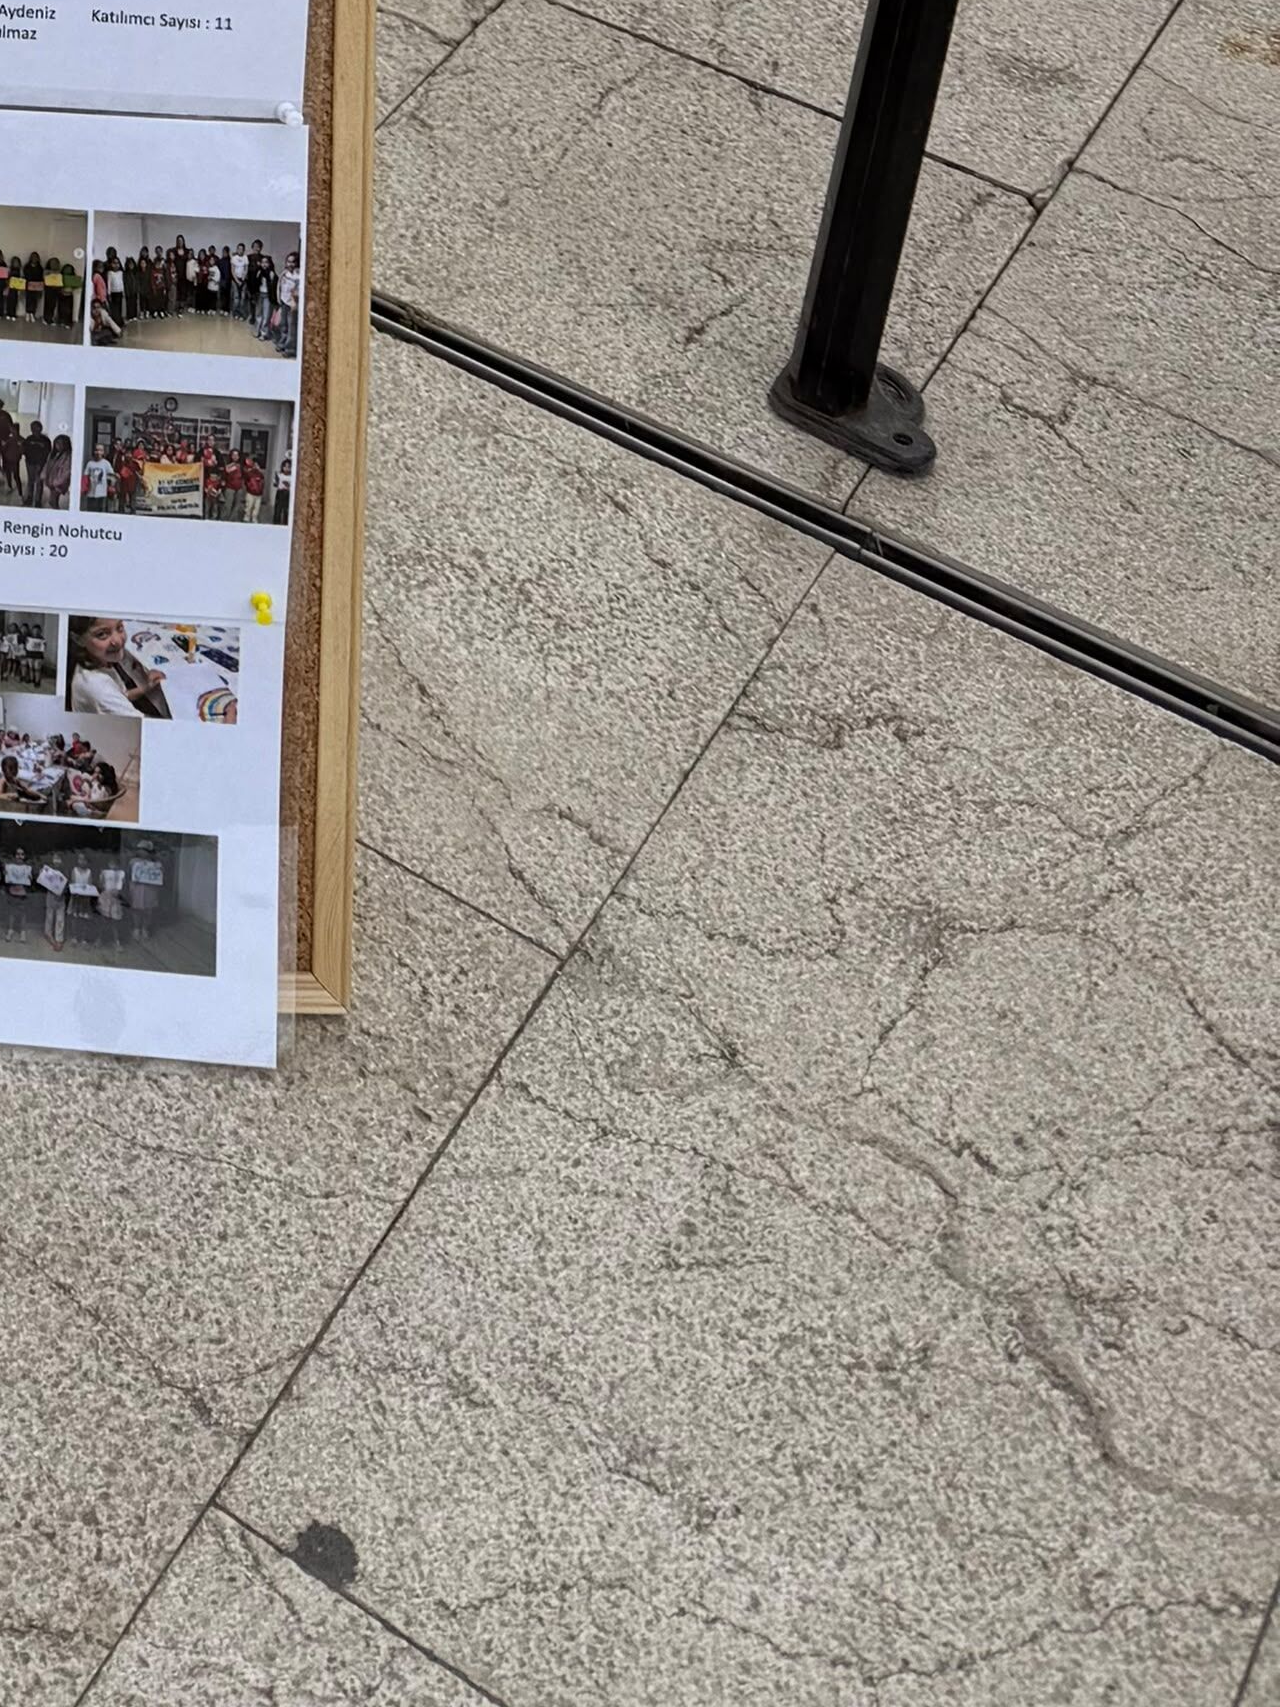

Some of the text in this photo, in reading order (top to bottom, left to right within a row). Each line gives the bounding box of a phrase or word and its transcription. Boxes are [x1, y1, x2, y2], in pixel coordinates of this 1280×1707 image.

[91, 9, 233, 30] Katılımcı Sayısı 11
[4, 521, 54, 538] Rengin
[58, 524, 122, 541] Nohutcu
[49, 545, 68, 558] 20
